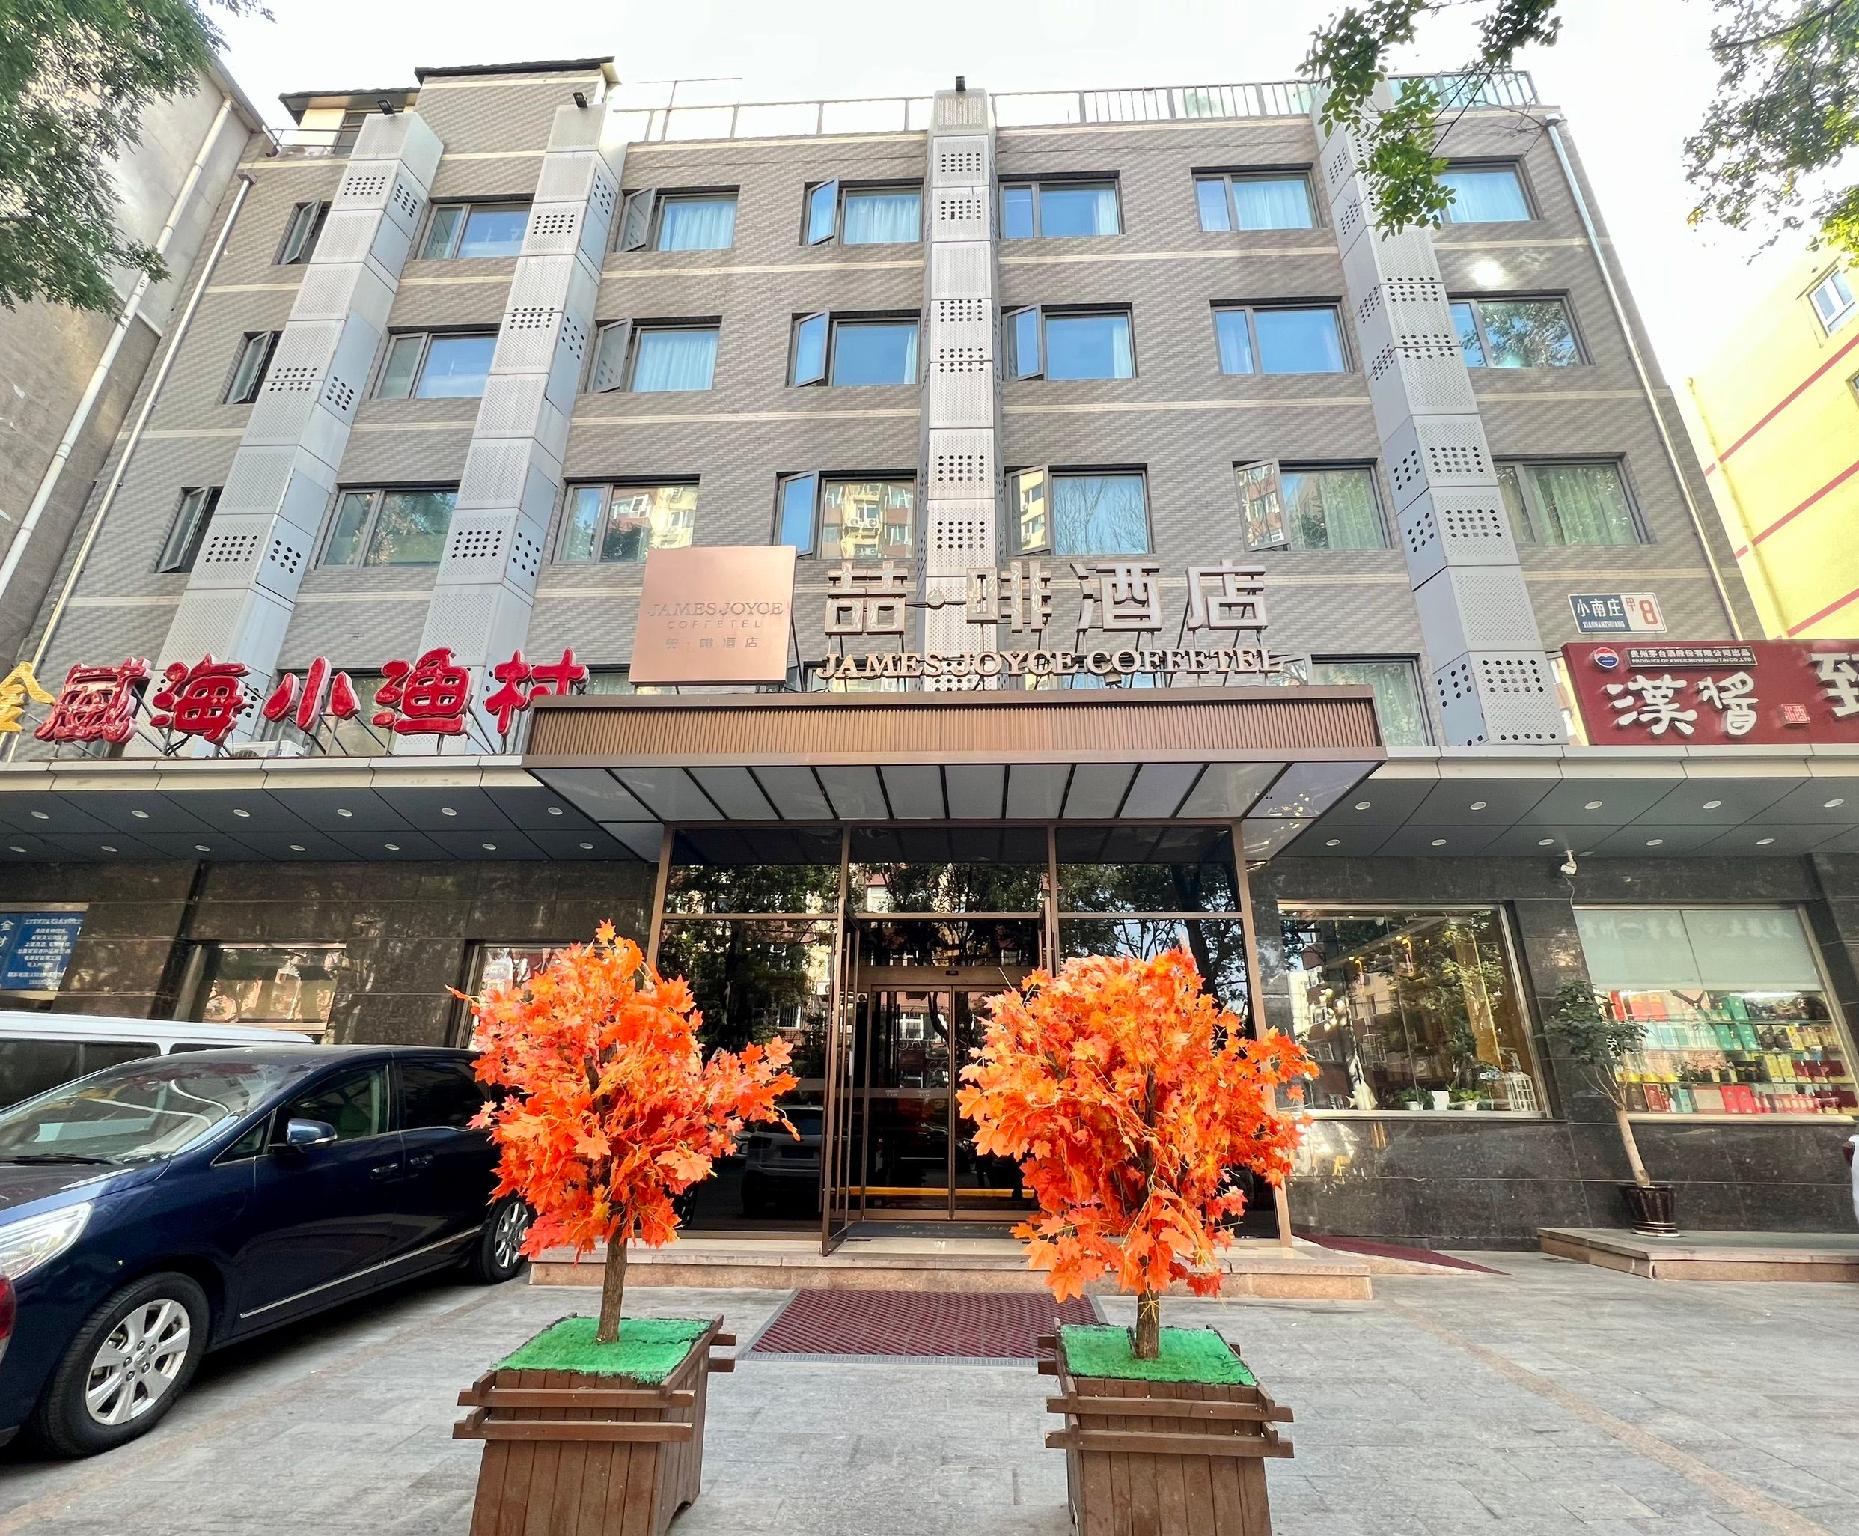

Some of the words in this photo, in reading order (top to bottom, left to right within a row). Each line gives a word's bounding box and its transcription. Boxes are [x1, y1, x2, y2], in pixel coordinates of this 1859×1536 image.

[648, 602, 715, 617] JAMES
[719, 602, 784, 616] JOYCE
[1577, 598, 1625, 617] 小南庄
[1638, 599, 1659, 625] 8
[816, 652, 944, 680] JAMES
[949, 650, 1076, 677] JOYCE
[1086, 648, 1284, 676] COFFETEL
